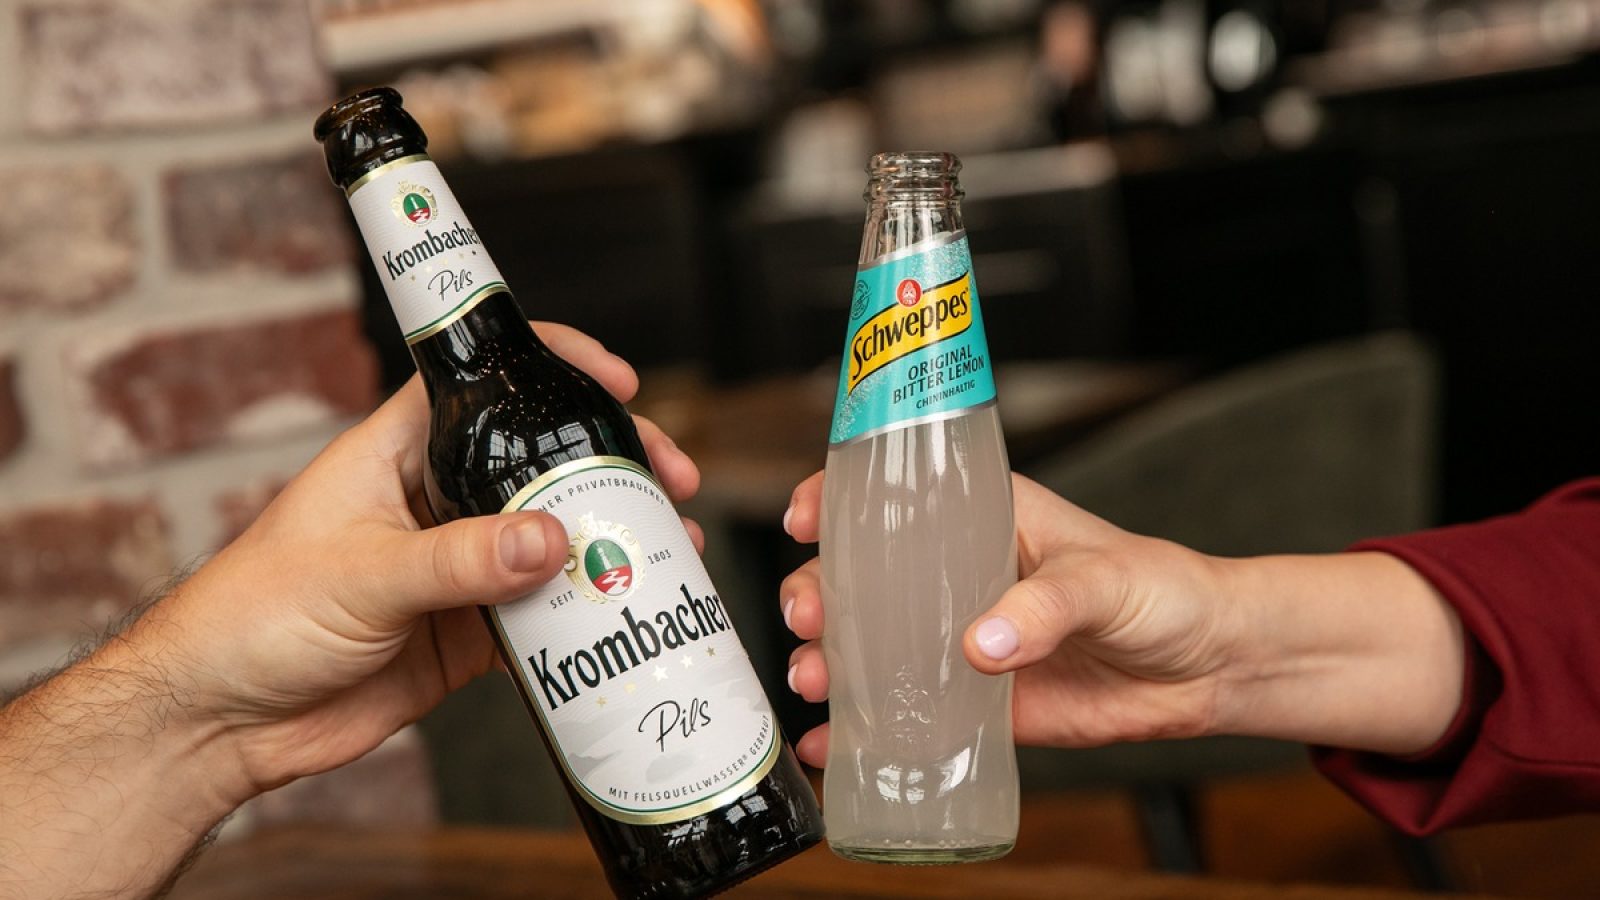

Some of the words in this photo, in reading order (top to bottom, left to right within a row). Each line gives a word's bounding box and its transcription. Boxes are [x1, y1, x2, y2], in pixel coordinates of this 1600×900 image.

[427, 269, 474, 301] Pils
[893, 371, 945, 405] BITTER
[948, 355, 985, 382] LEMON
[908, 344, 973, 381] ORIGINAL
[915, 379, 976, 409] CHININHALTIG
[550, 590, 575, 610] SEIT
[647, 549, 672, 565] 1803
[527, 583, 731, 711] Krombacher
[637, 697, 712, 753] Pils
[608, 786, 629, 801] MIT
[749, 714, 769, 756] GEBRAUT
